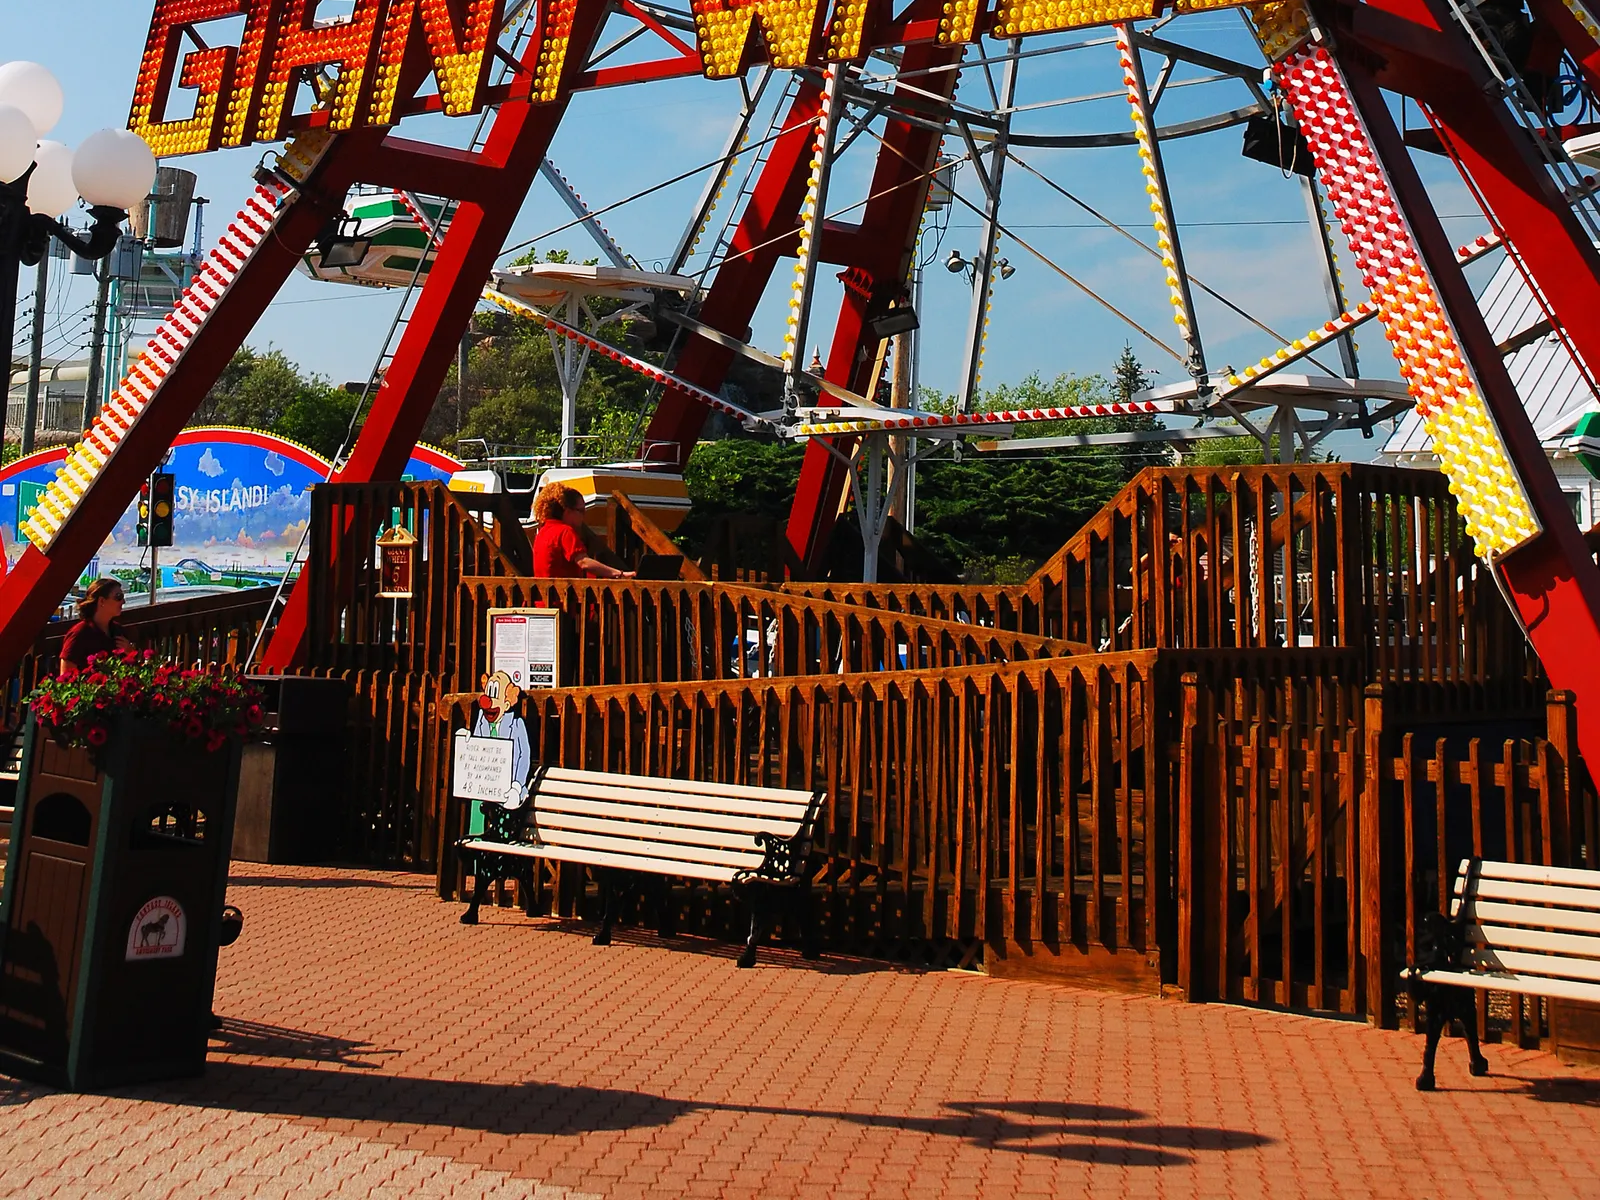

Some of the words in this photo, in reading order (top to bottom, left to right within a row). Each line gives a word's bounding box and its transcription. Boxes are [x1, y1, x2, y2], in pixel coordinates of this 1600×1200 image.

[205, 484, 269, 514] ISLAND!
[462, 781, 473, 793] 48
[477, 784, 502, 797] INCHES
